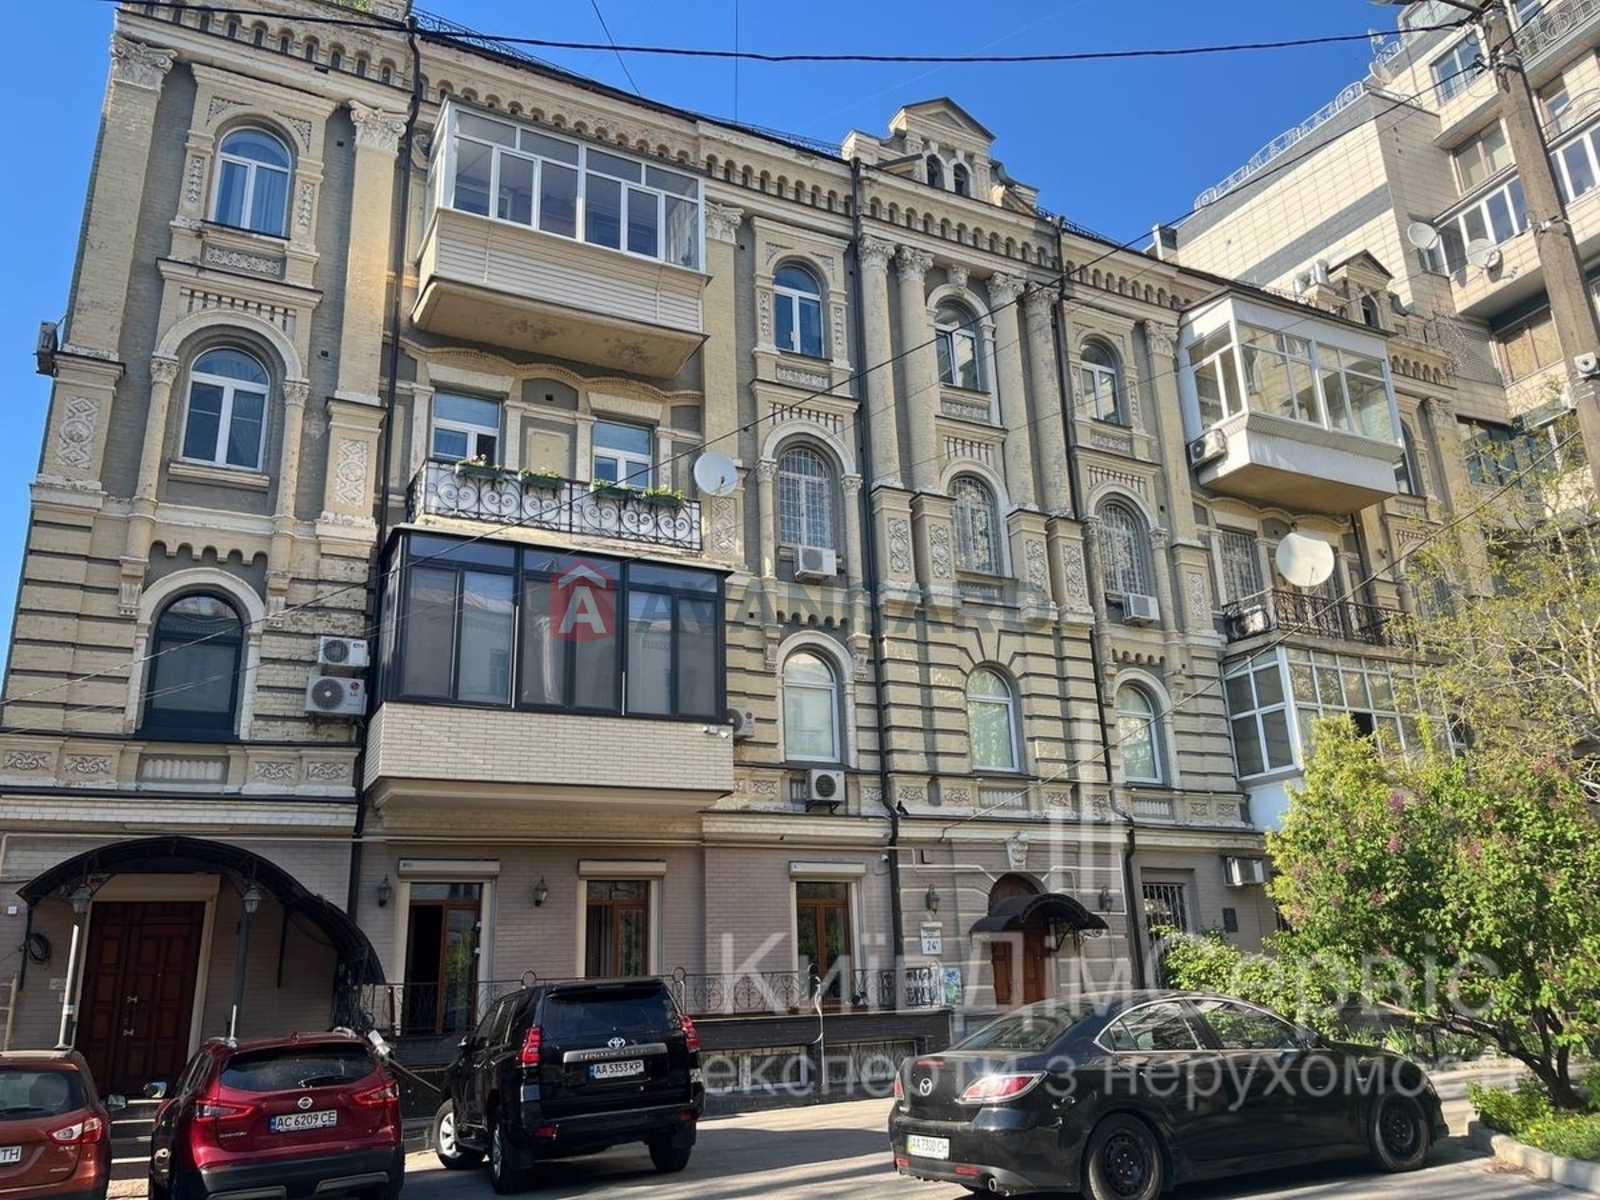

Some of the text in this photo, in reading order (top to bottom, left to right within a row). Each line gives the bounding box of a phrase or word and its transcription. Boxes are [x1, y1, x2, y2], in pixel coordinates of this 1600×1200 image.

[596, 1065, 608, 1075] AA
[608, 1063, 629, 1074] 5353
[276, 1111, 336, 1128] AC 6209 CE
